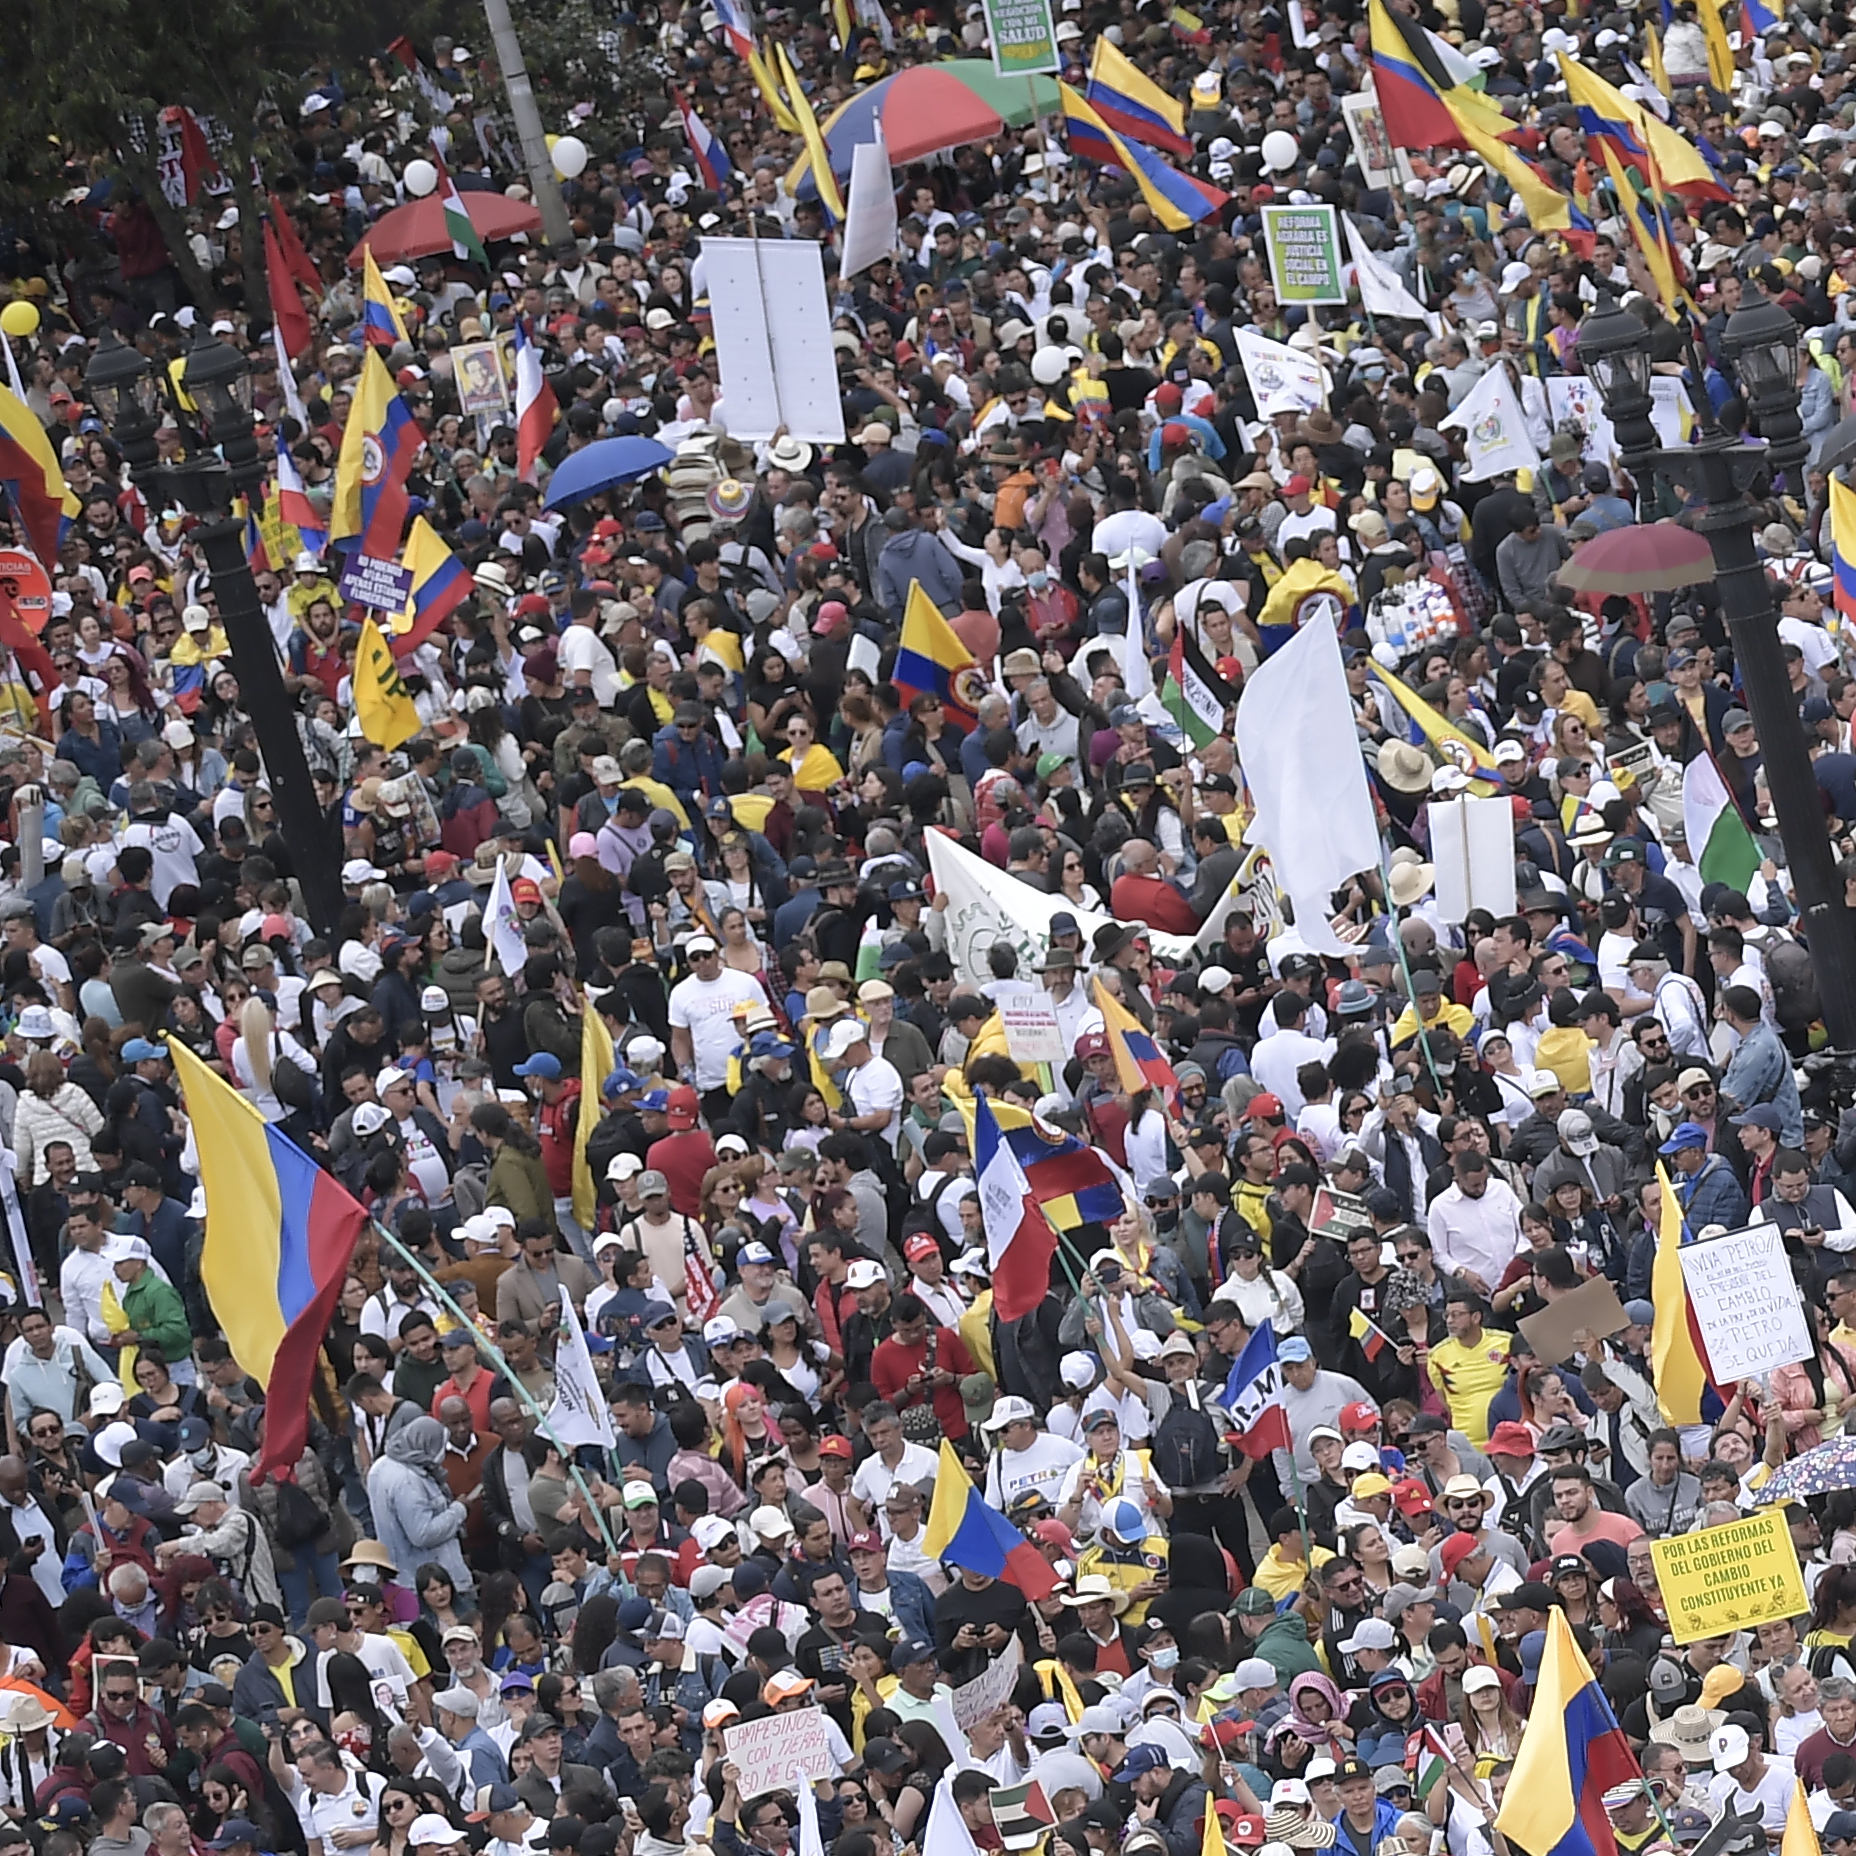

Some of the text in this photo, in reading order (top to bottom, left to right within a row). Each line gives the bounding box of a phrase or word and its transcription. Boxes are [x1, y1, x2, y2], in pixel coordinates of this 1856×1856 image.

[998, 25, 1046, 43] SALUD
[1277, 215, 1321, 229] REFORMA
[1756, 1269, 1778, 1281] DEL
[1718, 1285, 1772, 1311] CAMBIO
[1726, 1317, 1784, 1343] PETRO
[1723, 1335, 1799, 1369] SE QUEDA
[1662, 1519, 1773, 1560] POR LAS REFORMAS
[1669, 1538, 1775, 1577] DEL GOBIERNO DEL
[1703, 1563, 1750, 1587] CAMBIO
[1680, 1574, 1785, 1612] CONSTITUYENTE YA
[727, 1709, 818, 1751] CAMPESINOS
[746, 1728, 827, 1766] CON TIERRA
[739, 1752, 828, 1797] ESO ME GUSTA
